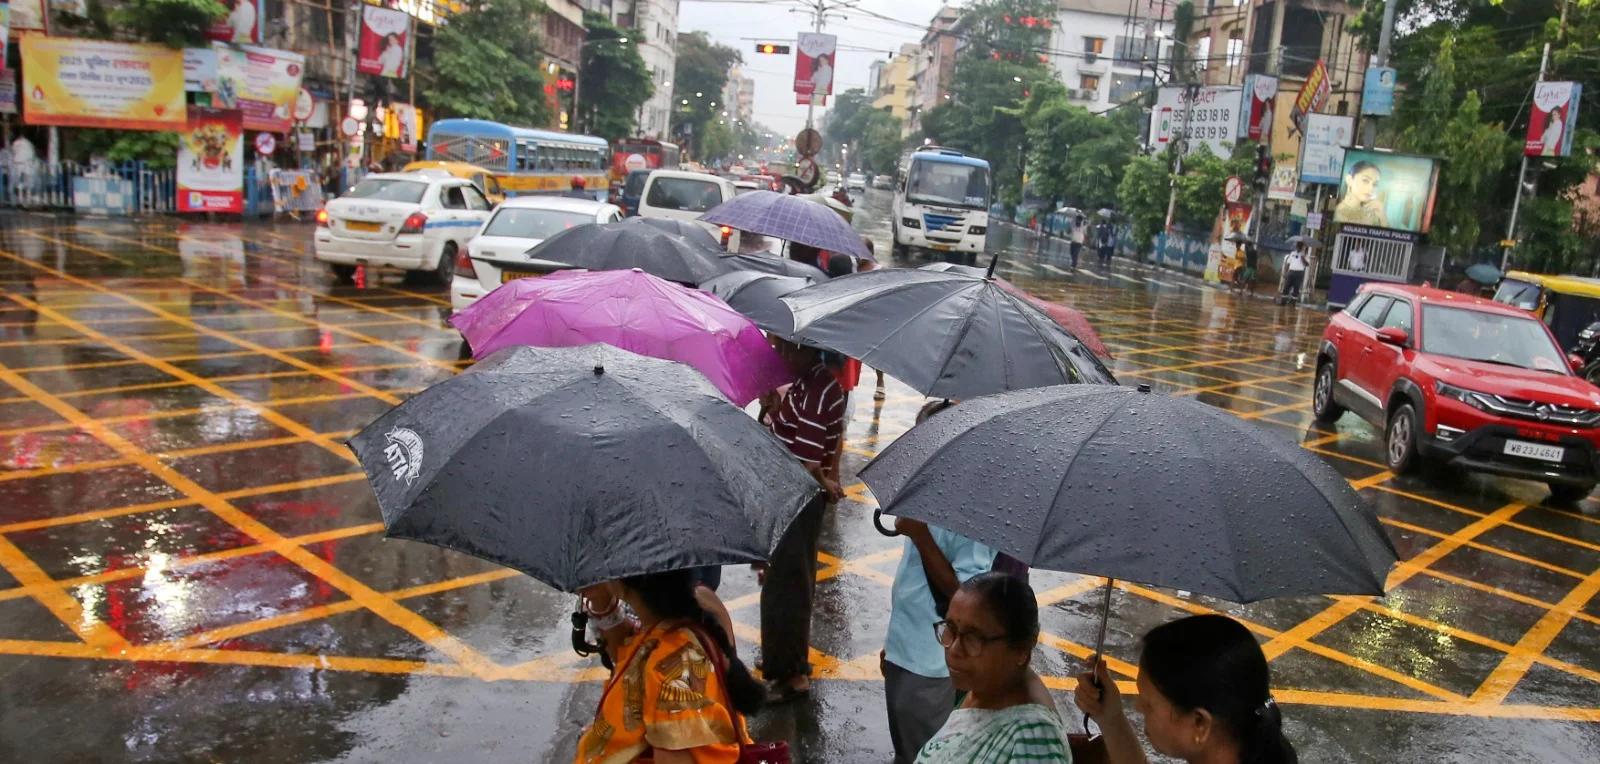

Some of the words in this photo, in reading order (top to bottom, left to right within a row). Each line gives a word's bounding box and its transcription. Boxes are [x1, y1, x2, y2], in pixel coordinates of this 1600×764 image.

[1178, 92, 1216, 104] COACT
[1536, 85, 1559, 107] Lyra
[1343, 226, 1368, 234] KOLKATA
[1369, 229, 1390, 237] TRAFFIC
[1392, 232, 1411, 240] POLICE
[1512, 445, 1522, 453] WB
[383, 442, 409, 481] ATTA
